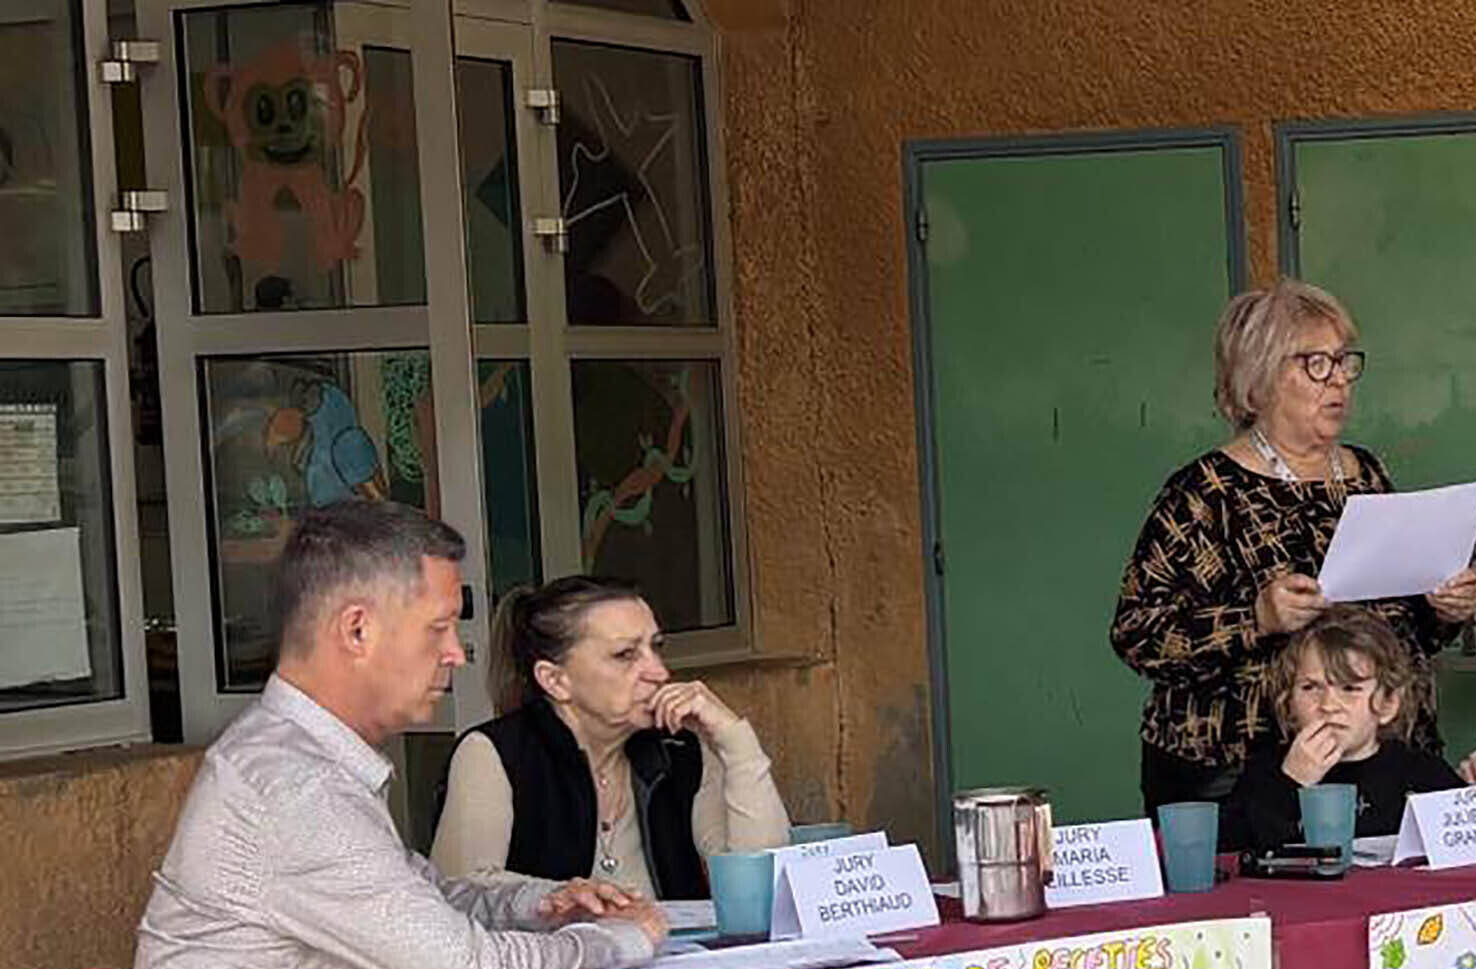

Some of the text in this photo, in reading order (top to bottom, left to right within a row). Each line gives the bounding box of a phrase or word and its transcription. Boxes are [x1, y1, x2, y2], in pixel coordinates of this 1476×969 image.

[1056, 826, 1102, 845] JURY
[833, 853, 875, 874] JURY
[1053, 847, 1112, 866] MARIA
[834, 873, 886, 896] DAVID
[817, 892, 913, 922] BERTHIAUD
